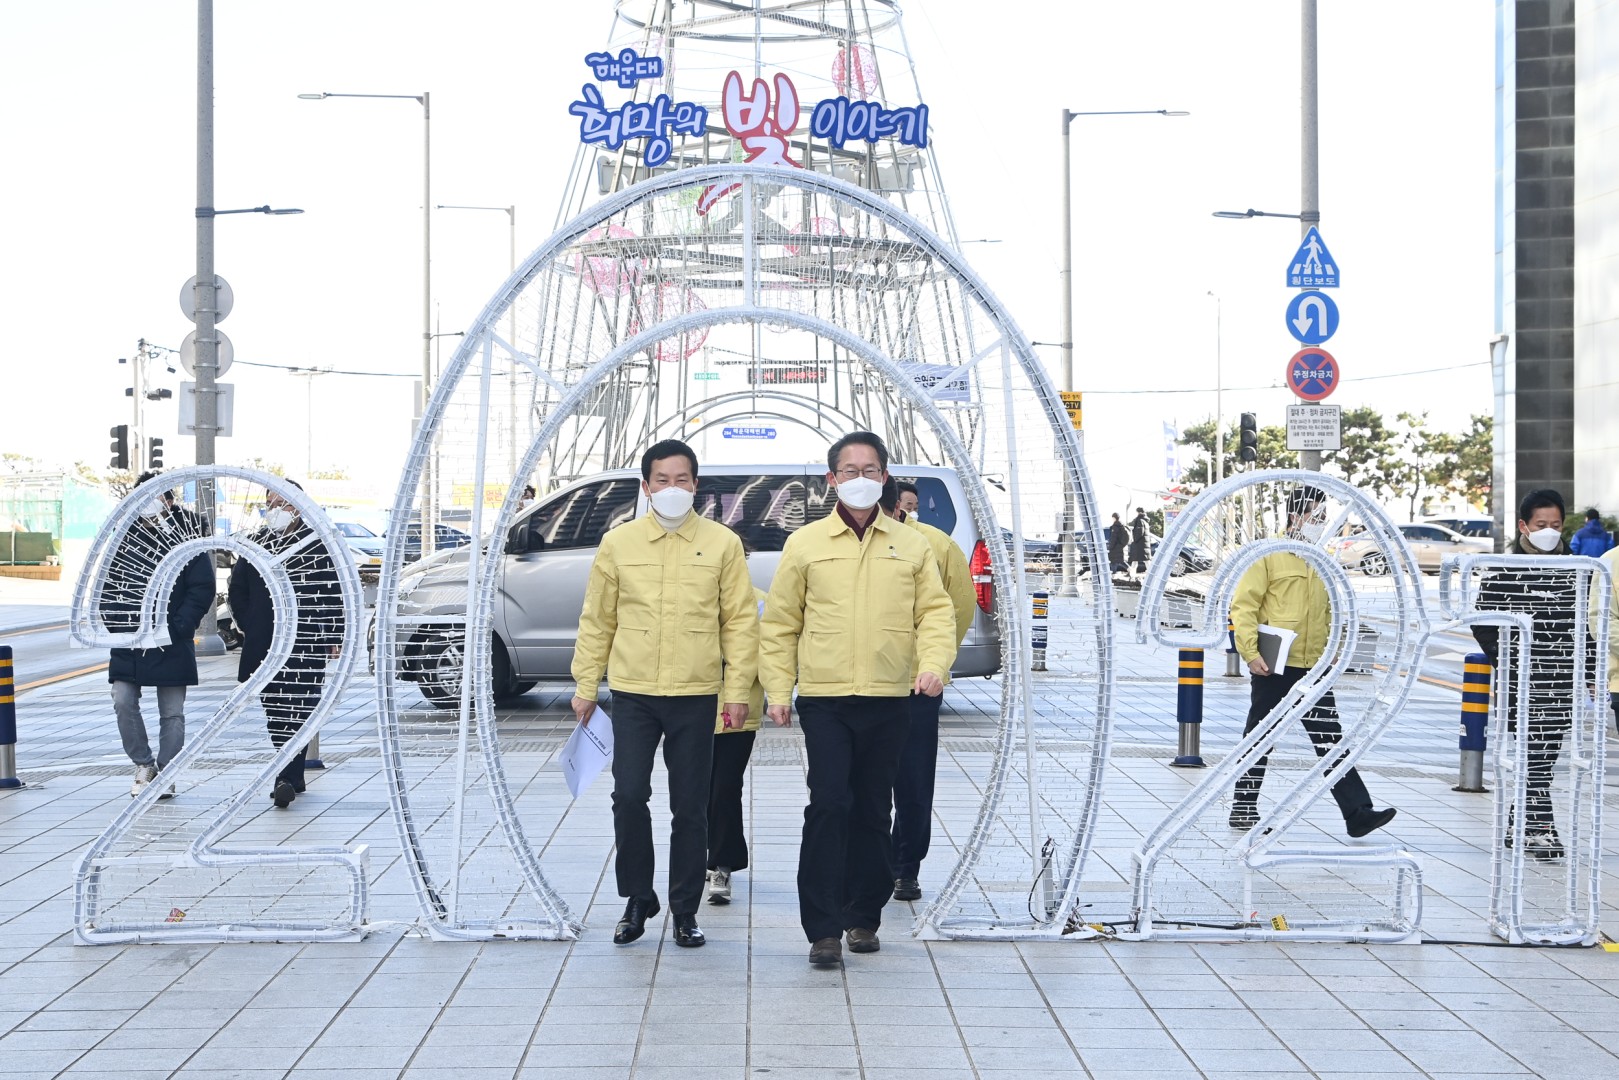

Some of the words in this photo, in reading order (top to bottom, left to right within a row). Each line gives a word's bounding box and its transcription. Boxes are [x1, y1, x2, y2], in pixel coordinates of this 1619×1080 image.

[587, 51, 660, 86] 해운대
[571, 87, 704, 164] 희망의
[814, 100, 927, 147] 이야기
[1290, 273, 1337, 286] 횡단보도
[1293, 369, 1333, 379] 주정차금지
